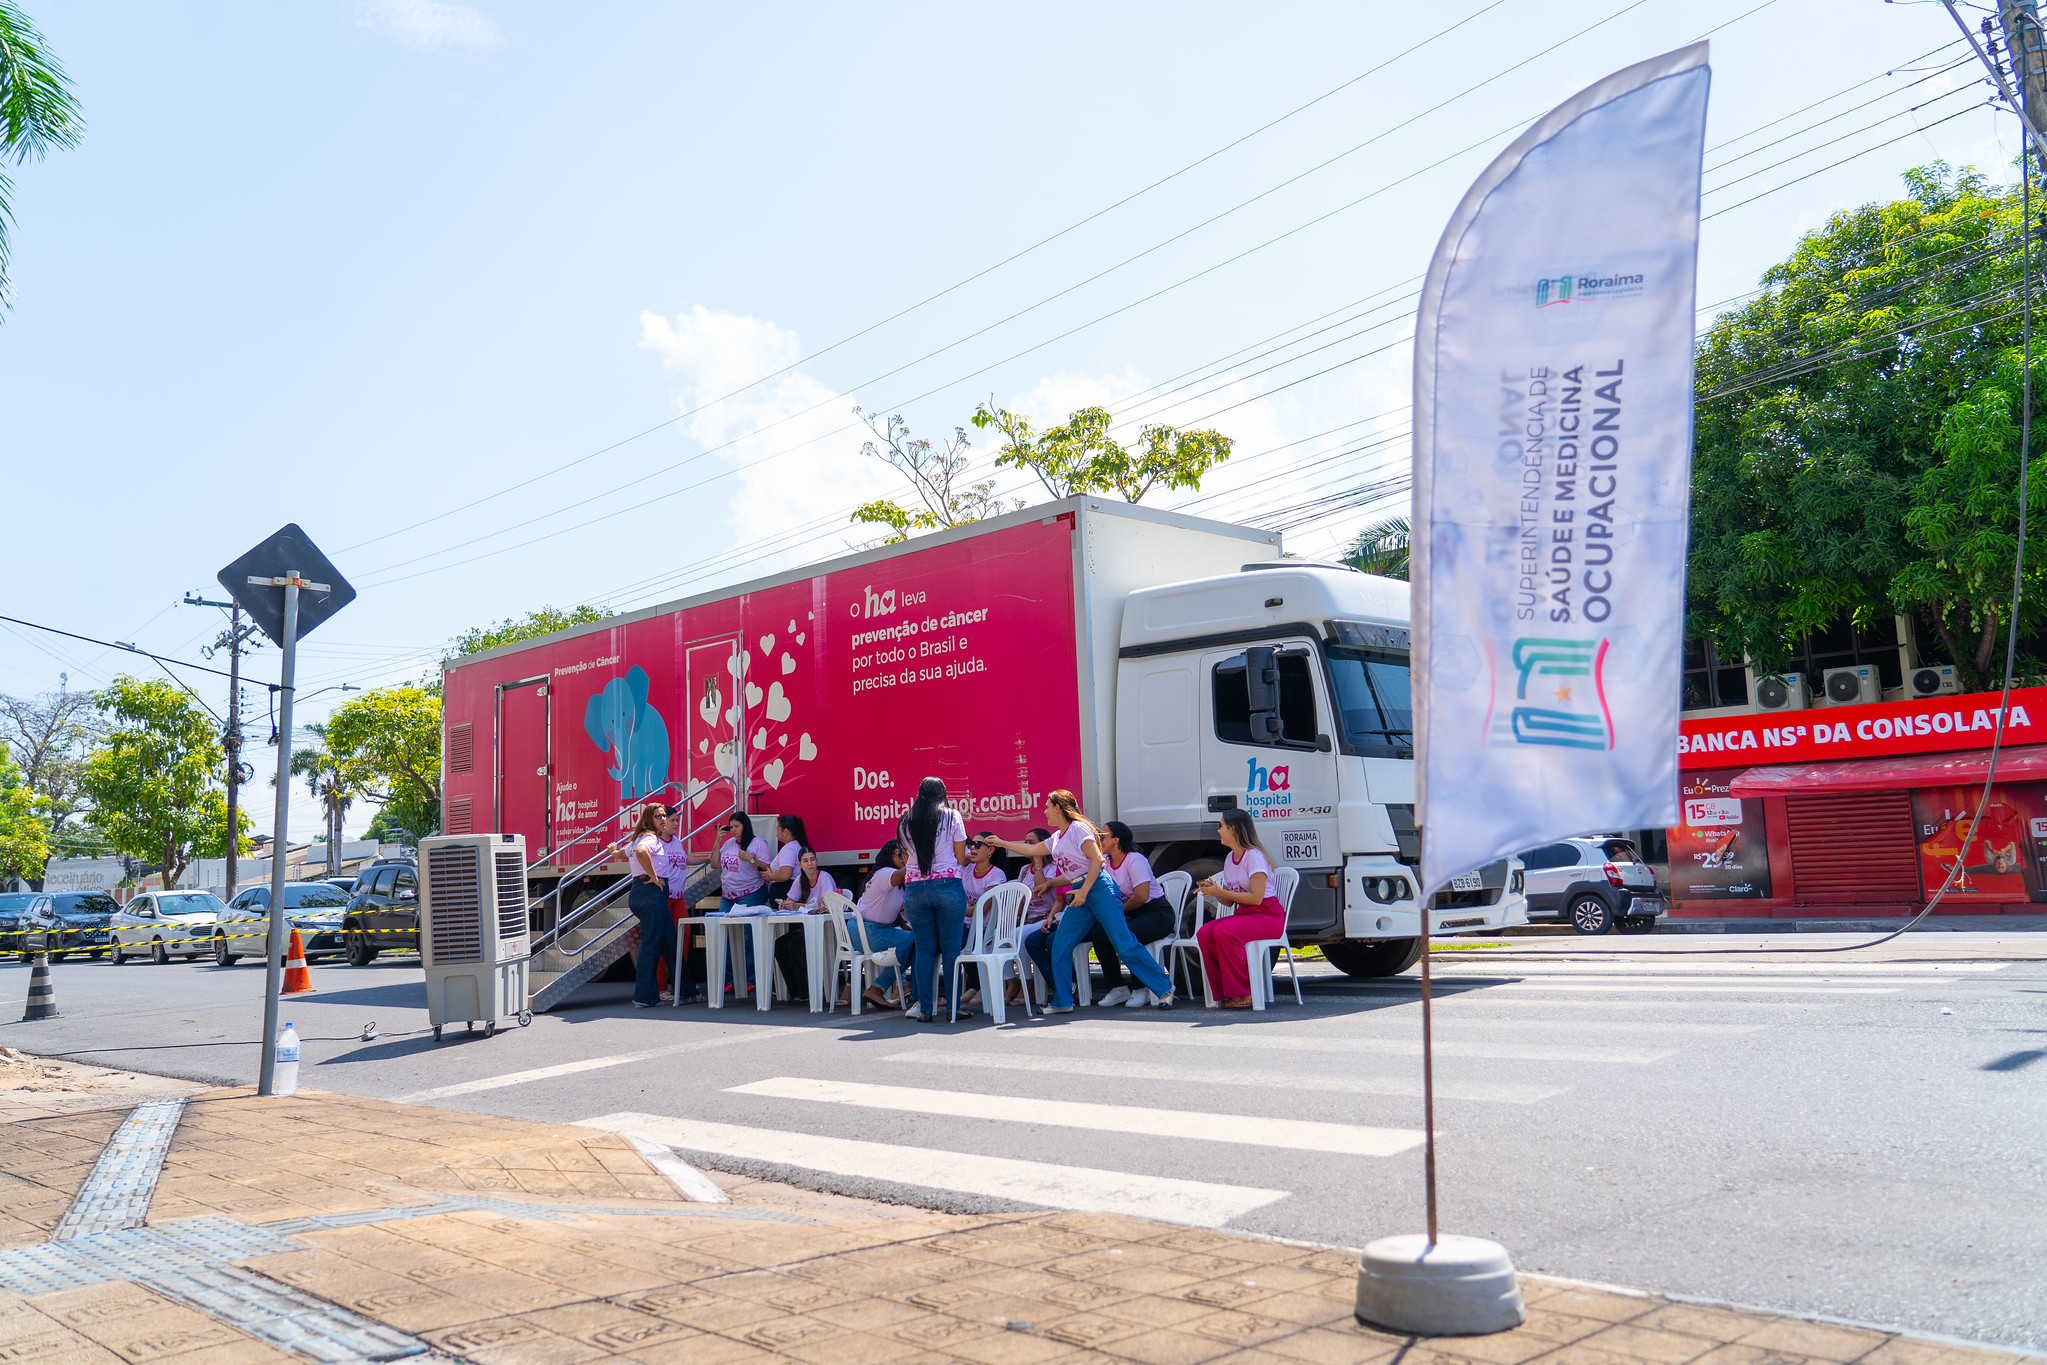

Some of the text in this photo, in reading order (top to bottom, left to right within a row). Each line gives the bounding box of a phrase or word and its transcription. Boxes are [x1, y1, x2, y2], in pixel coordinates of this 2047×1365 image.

[1578, 274, 1644, 290] Roraima
[1517, 366, 1548, 620] SUPERINTENDÊNCIA DE
[1545, 365, 1584, 623] SAÚDE E MEDICINA
[1582, 359, 1624, 623] OCUPACIONAL
[850, 585, 927, 619] o ha leva
[852, 607, 989, 650] prevenção de câncer
[852, 635, 968, 673] por todo o Brasil e
[554, 655, 620, 677] Prevenção de Câncer
[853, 656, 988, 696] precisa da sua ajuda.
[1678, 730, 1758, 754] BANCA
[1813, 722, 1852, 744] DA
[1856, 705, 2031, 741] CONSOLATA
[854, 767, 895, 791] Doe.
[1246, 757, 1291, 792] ha
[556, 781, 578, 794] Ajude o
[1683, 784, 1730, 795] Eu Prez
[555, 795, 577, 823] ha
[577, 799, 598, 811] hospital
[1246, 792, 1291, 808] hospital
[578, 809, 598, 819] de amor
[1247, 806, 1292, 818] de amor
[1297, 806, 1332, 814] 2430
[1688, 804, 1706, 820] 15
[1284, 833, 1318, 842] RORAIMA
[1286, 845, 1318, 859] RR-01
[1729, 884, 1750, 893] Claro
